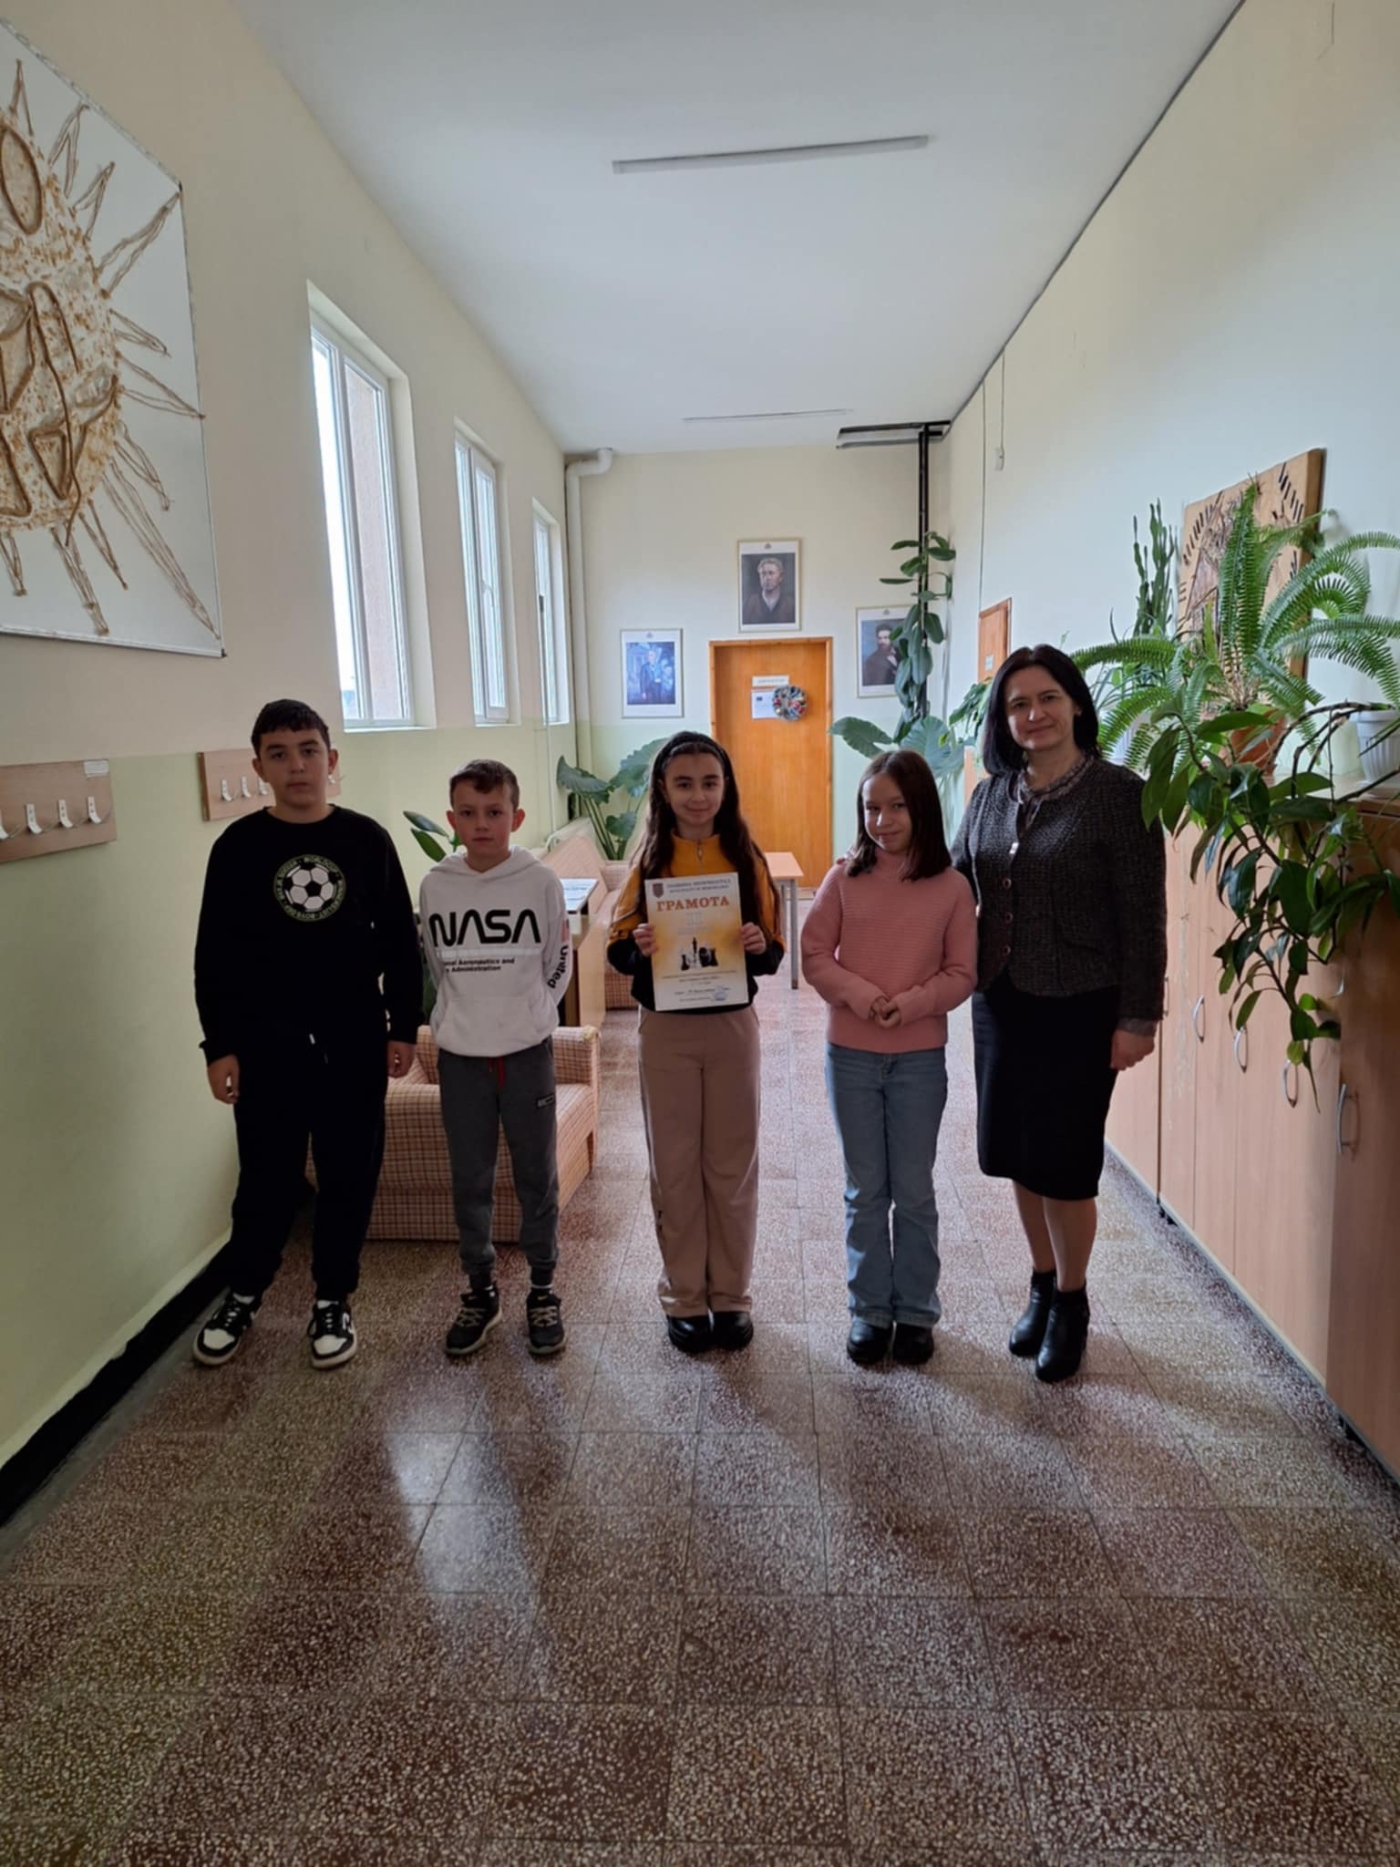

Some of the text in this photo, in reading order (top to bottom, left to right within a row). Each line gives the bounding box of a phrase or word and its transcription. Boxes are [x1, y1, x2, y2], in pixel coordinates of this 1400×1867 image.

[656, 896, 729, 912] ГРАМОТА
[428, 909, 542, 947] NASA
[547, 945, 568, 989] United
